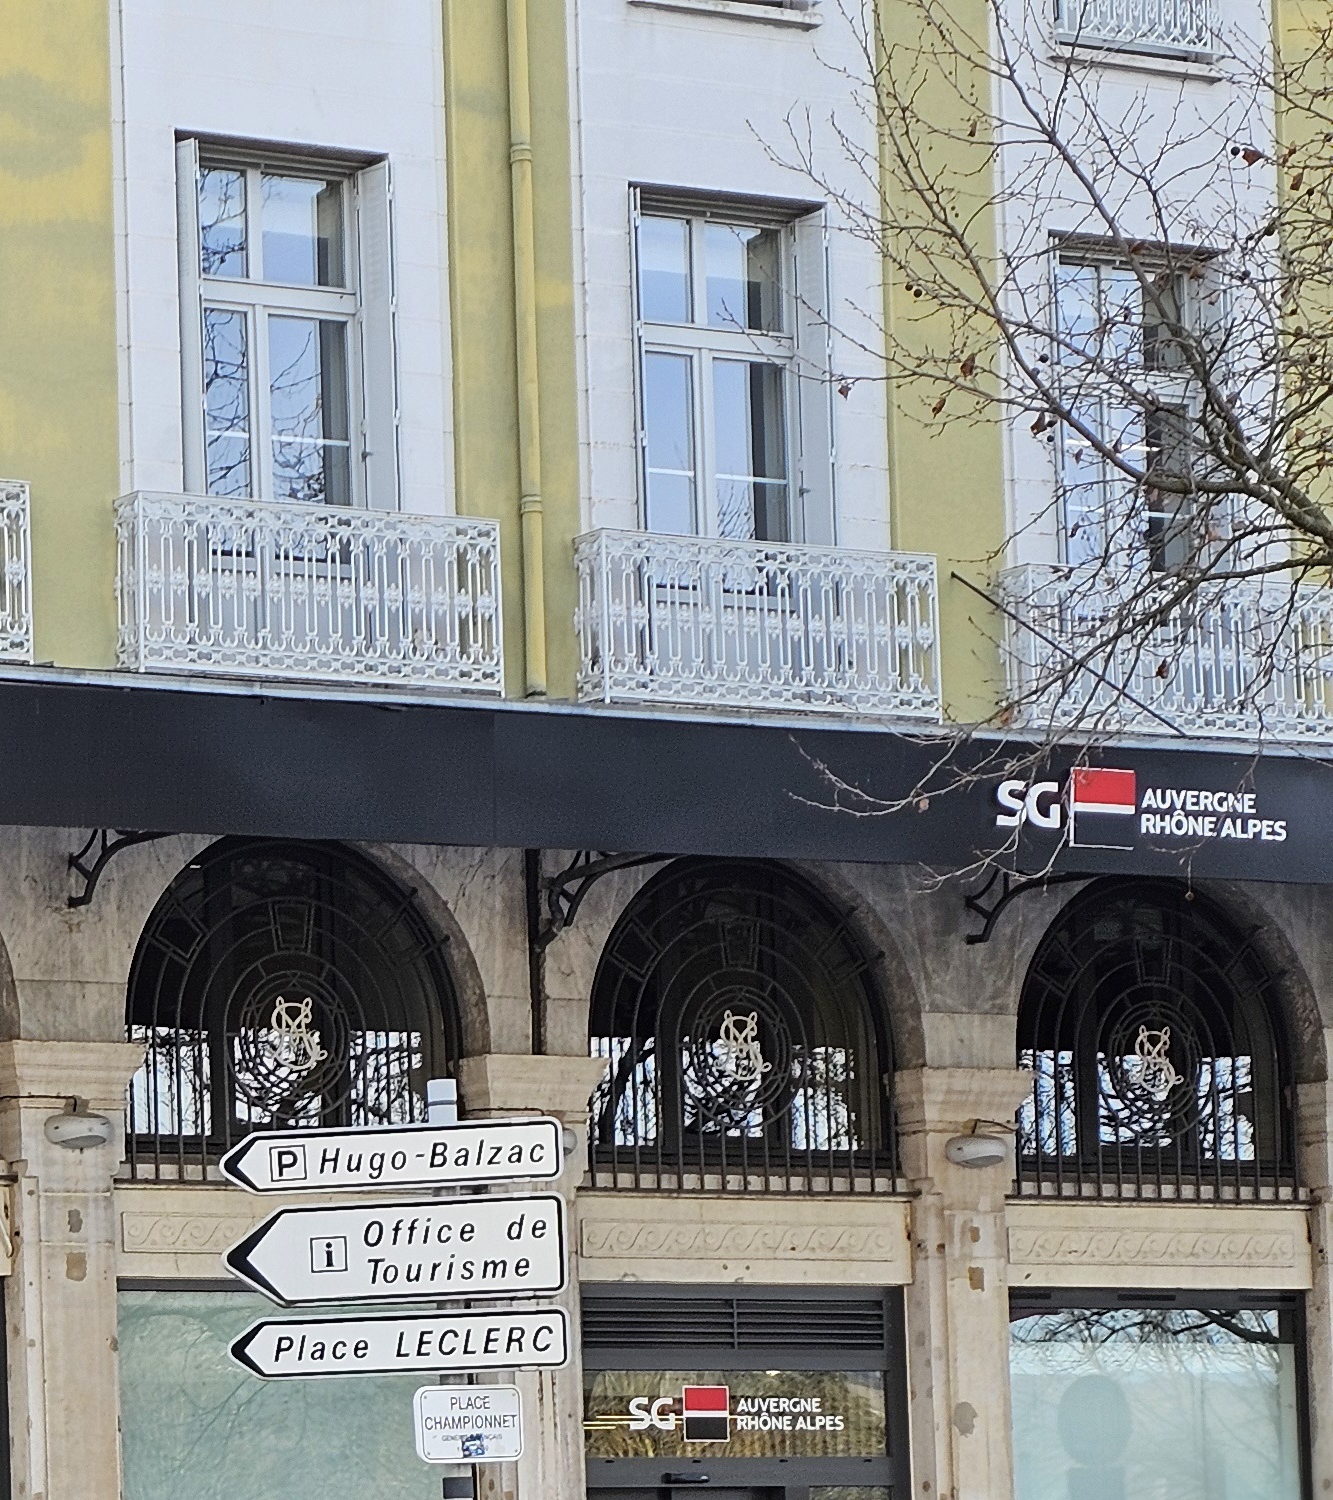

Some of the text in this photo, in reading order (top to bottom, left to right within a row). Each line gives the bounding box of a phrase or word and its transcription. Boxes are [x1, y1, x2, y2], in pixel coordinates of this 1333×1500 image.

[996, 780, 1061, 829] SG
[1140, 788, 1257, 814] AUVERGNE
[1140, 810, 1287, 842] RHÔNE ALPES
[319, 1138, 546, 1180] Hugo-Balzac
[362, 1213, 548, 1248] Office de
[367, 1253, 531, 1285] Tourisme
[273, 1325, 554, 1363] Place LECLERC
[450, 1395, 491, 1411] PLACE
[629, 1396, 676, 1431] SG
[736, 1397, 822, 1413] AUVERGNE
[424, 1414, 518, 1431] CHAMPIONNET
[736, 1413, 845, 1431] RHÔNE ALPES
